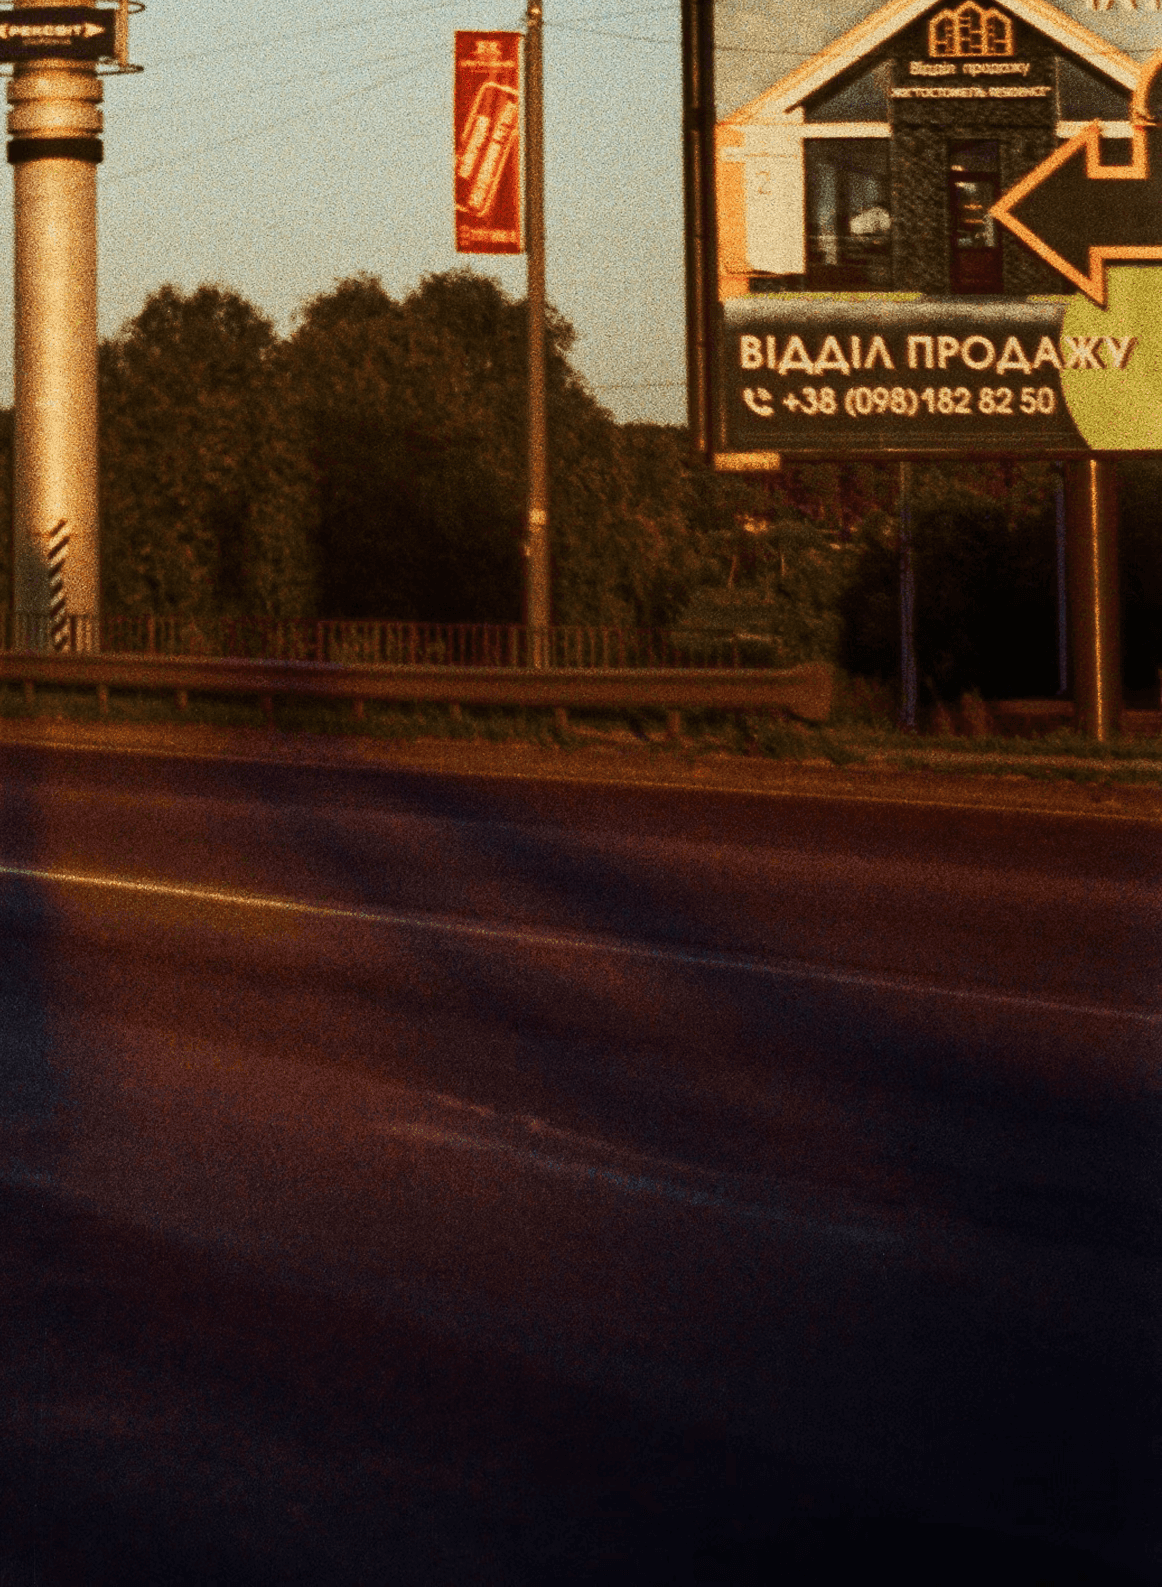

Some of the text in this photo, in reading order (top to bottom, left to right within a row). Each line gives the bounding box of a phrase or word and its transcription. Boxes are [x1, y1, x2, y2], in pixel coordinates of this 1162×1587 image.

[739, 334, 1139, 376] ВІДДІЛ ПРОДАЖУ
[782, 386, 838, 415] +38
[978, 386, 1015, 415] 82
[1019, 386, 1056, 415] 50
